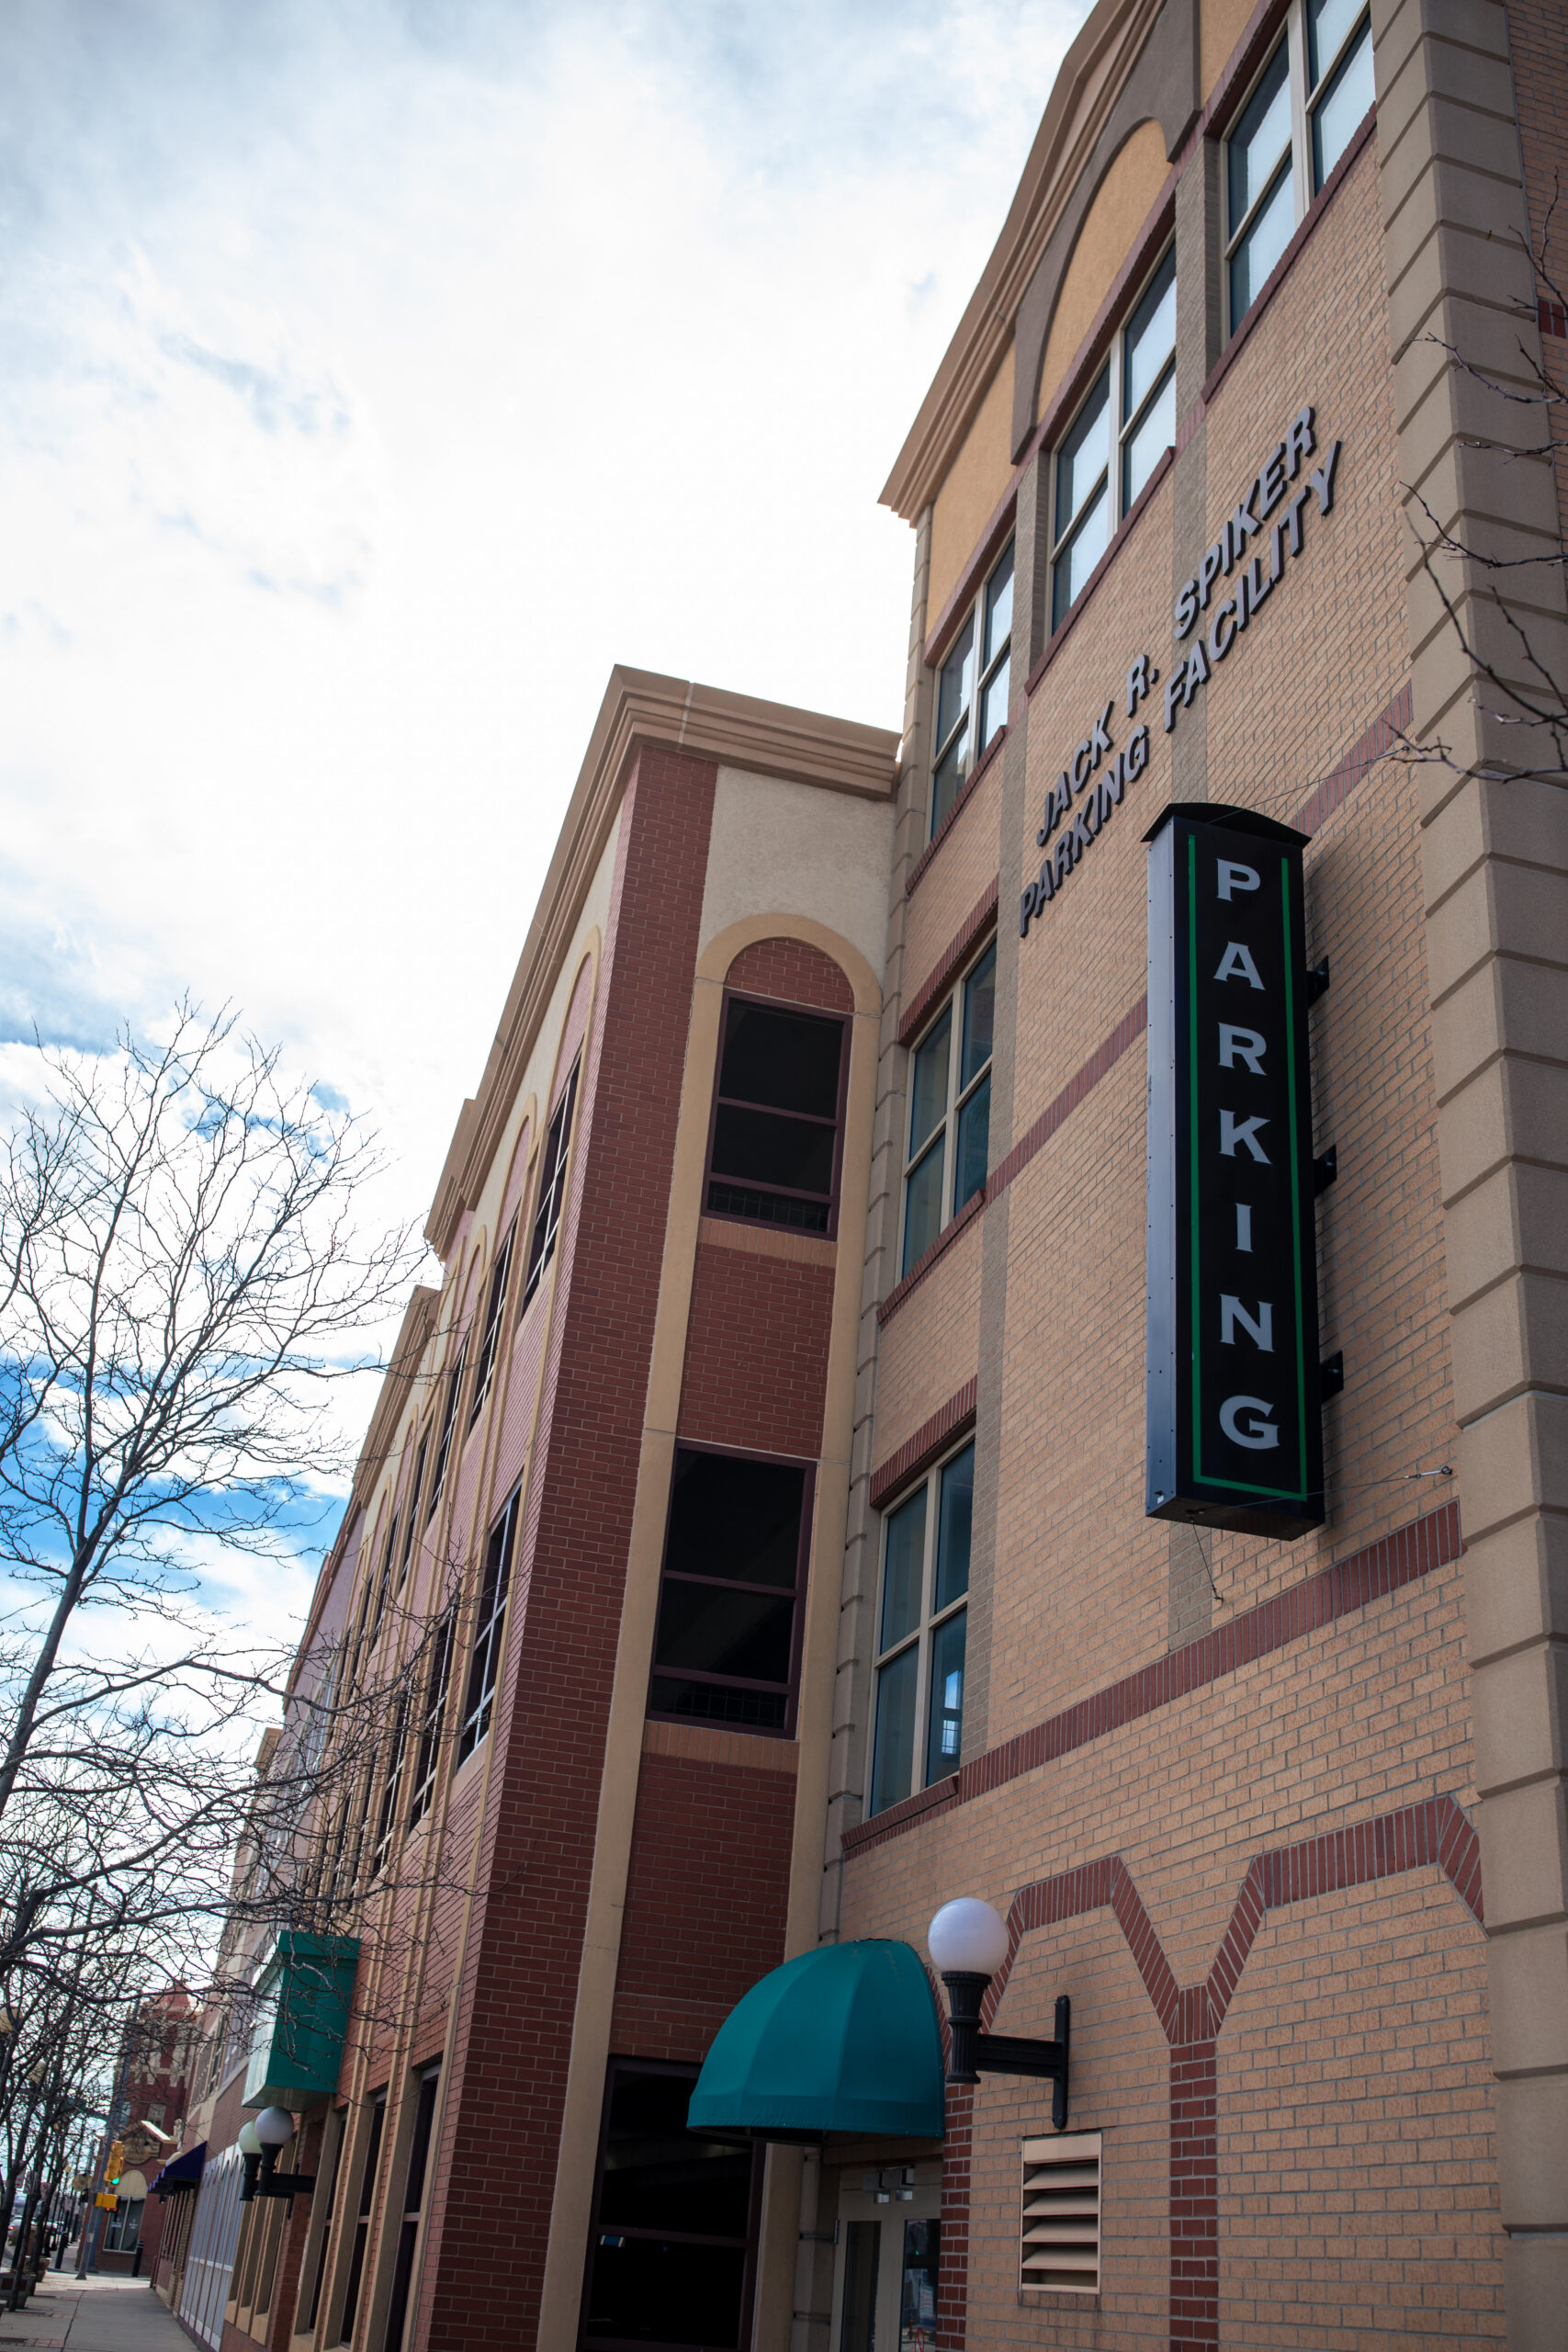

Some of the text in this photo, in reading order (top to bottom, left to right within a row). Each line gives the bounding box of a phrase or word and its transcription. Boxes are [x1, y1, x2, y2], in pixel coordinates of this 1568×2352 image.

[1020, 440, 1342, 938] PARKING FACILITY
[1036, 406, 1316, 846] JACK R. SPIKER
[1213, 858, 1280, 1450] PARKING
